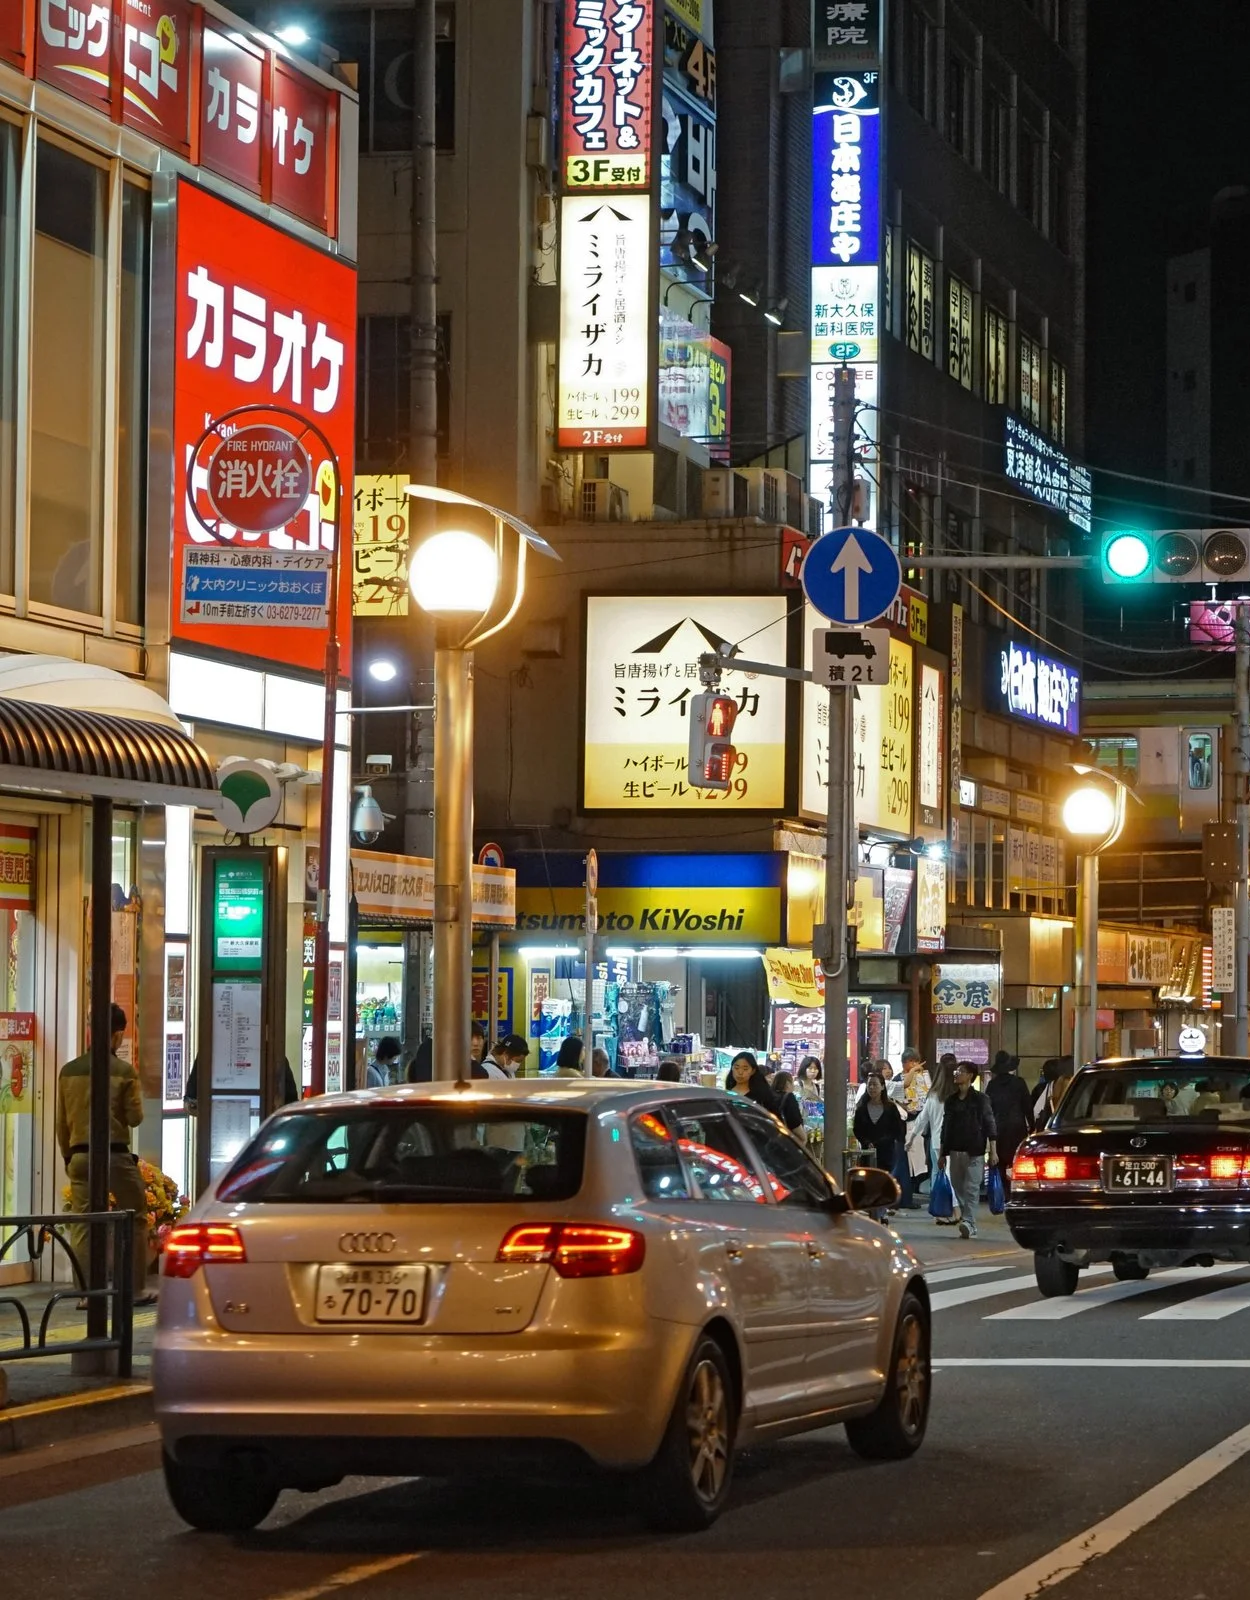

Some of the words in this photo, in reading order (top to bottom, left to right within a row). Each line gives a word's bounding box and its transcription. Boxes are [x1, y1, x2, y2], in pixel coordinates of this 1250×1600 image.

[826, 2, 869, 46] 療院
[863, 71, 879, 84] 3F
[207, 66, 314, 175] カラオケ
[581, 234, 606, 377] ミライザカ
[814, 303, 874, 319] 新大久保
[814, 321, 874, 337] 歯科医院
[186, 265, 344, 413] カラオケ
[834, 344, 855, 357] 2F
[815, 370, 874, 381] COEE
[582, 429, 624, 445] 2F受付
[226, 440, 248, 452] FIRE
[250, 440, 295, 452] HYDRANT
[218, 458, 303, 499] 消火栓
[202, 579, 323, 594] 大内クリニックおおくぼ
[202, 603, 264, 618] 10m手前左折すぐ
[266, 605, 322, 620] 03-6279-2277
[623, 754, 689, 773] ハイボール
[622, 780, 689, 799] 生ビール
[639, 908, 745, 931] KiYoshi
[934, 978, 991, 1009] 金の蔵
[982, 1012, 996, 1023] B1
[1141, 1161, 1156, 1170] 500
[1123, 1170, 1165, 1186] 61-44
[341, 1288, 417, 1316] 70-70
